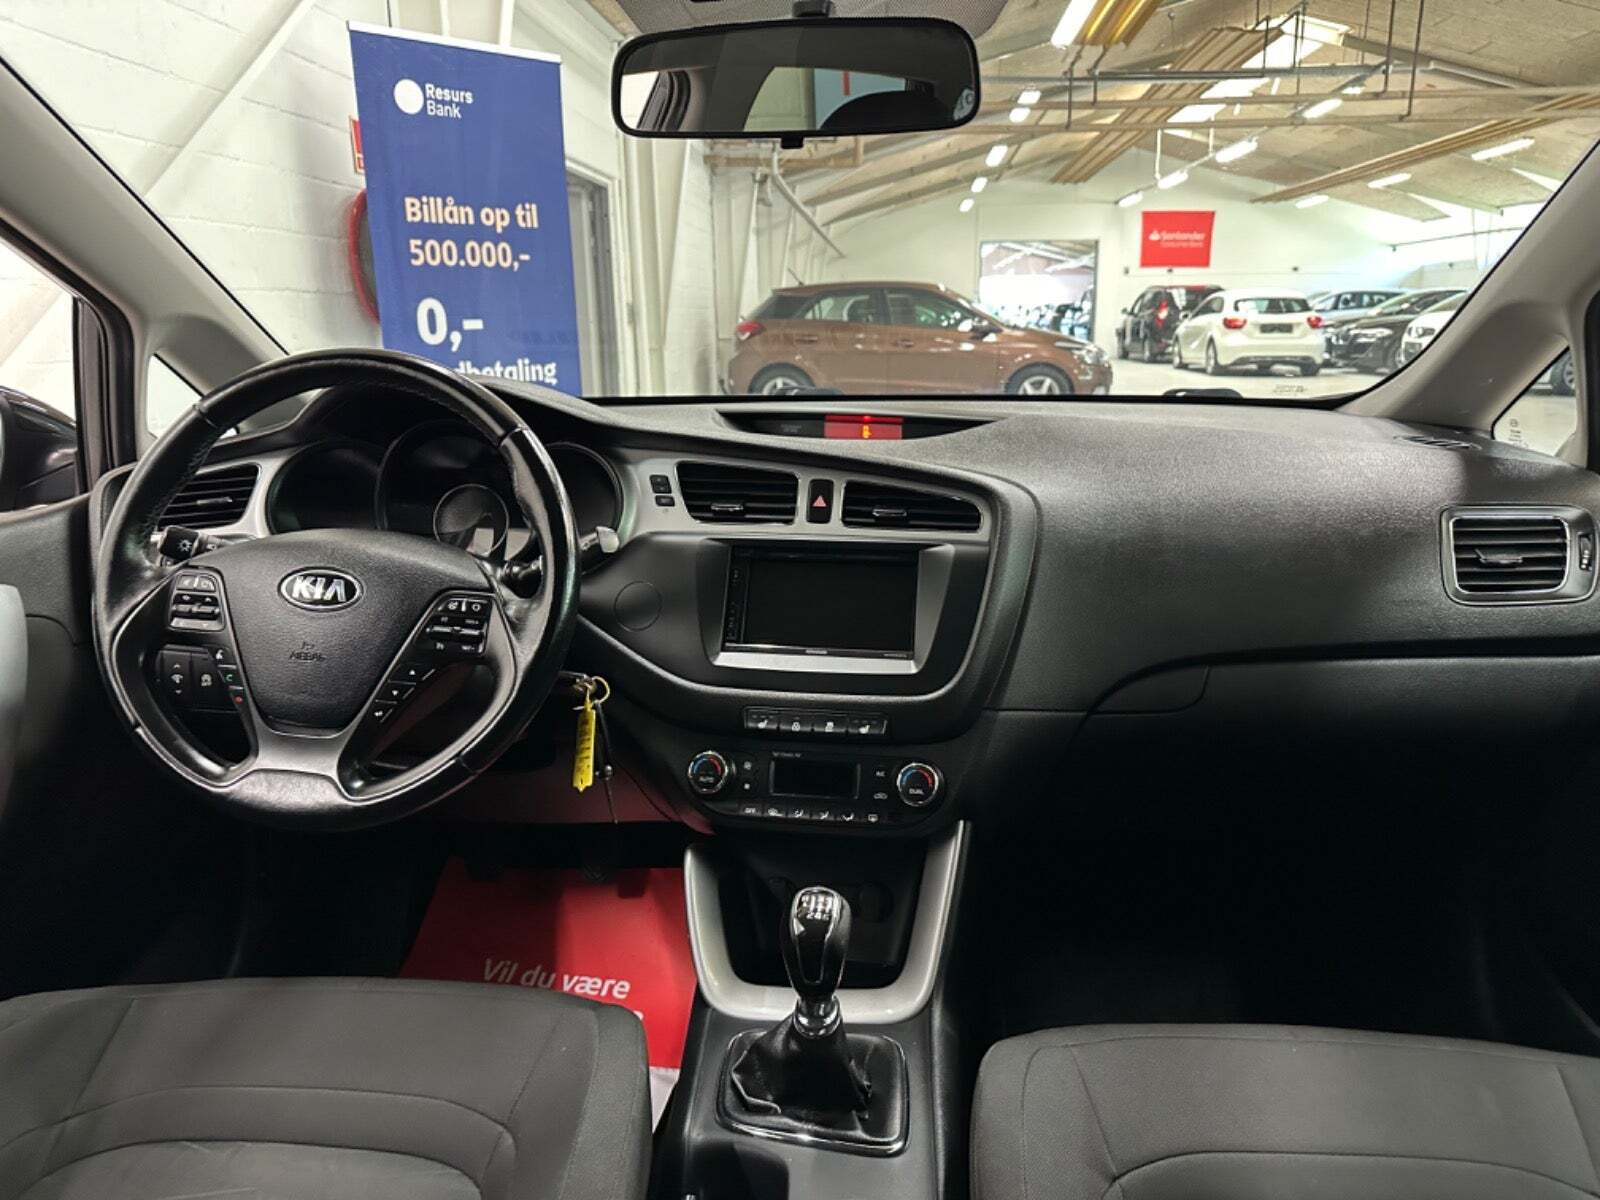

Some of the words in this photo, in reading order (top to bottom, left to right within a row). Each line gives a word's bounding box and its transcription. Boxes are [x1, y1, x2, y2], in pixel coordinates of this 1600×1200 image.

[425, 83, 473, 104] Resurs
[426, 100, 462, 119] Bank
[404, 196, 475, 225] Billån
[480, 206, 511, 233] op
[515, 202, 539, 229] til
[409, 239, 531, 272] 500.000,-
[416, 297, 484, 352] 0,-
[454, 358, 558, 386] dbetaling
[292, 576, 347, 602] KIA
[483, 958, 519, 983] Vil
[520, 964, 556, 989] du
[562, 974, 631, 999] være
